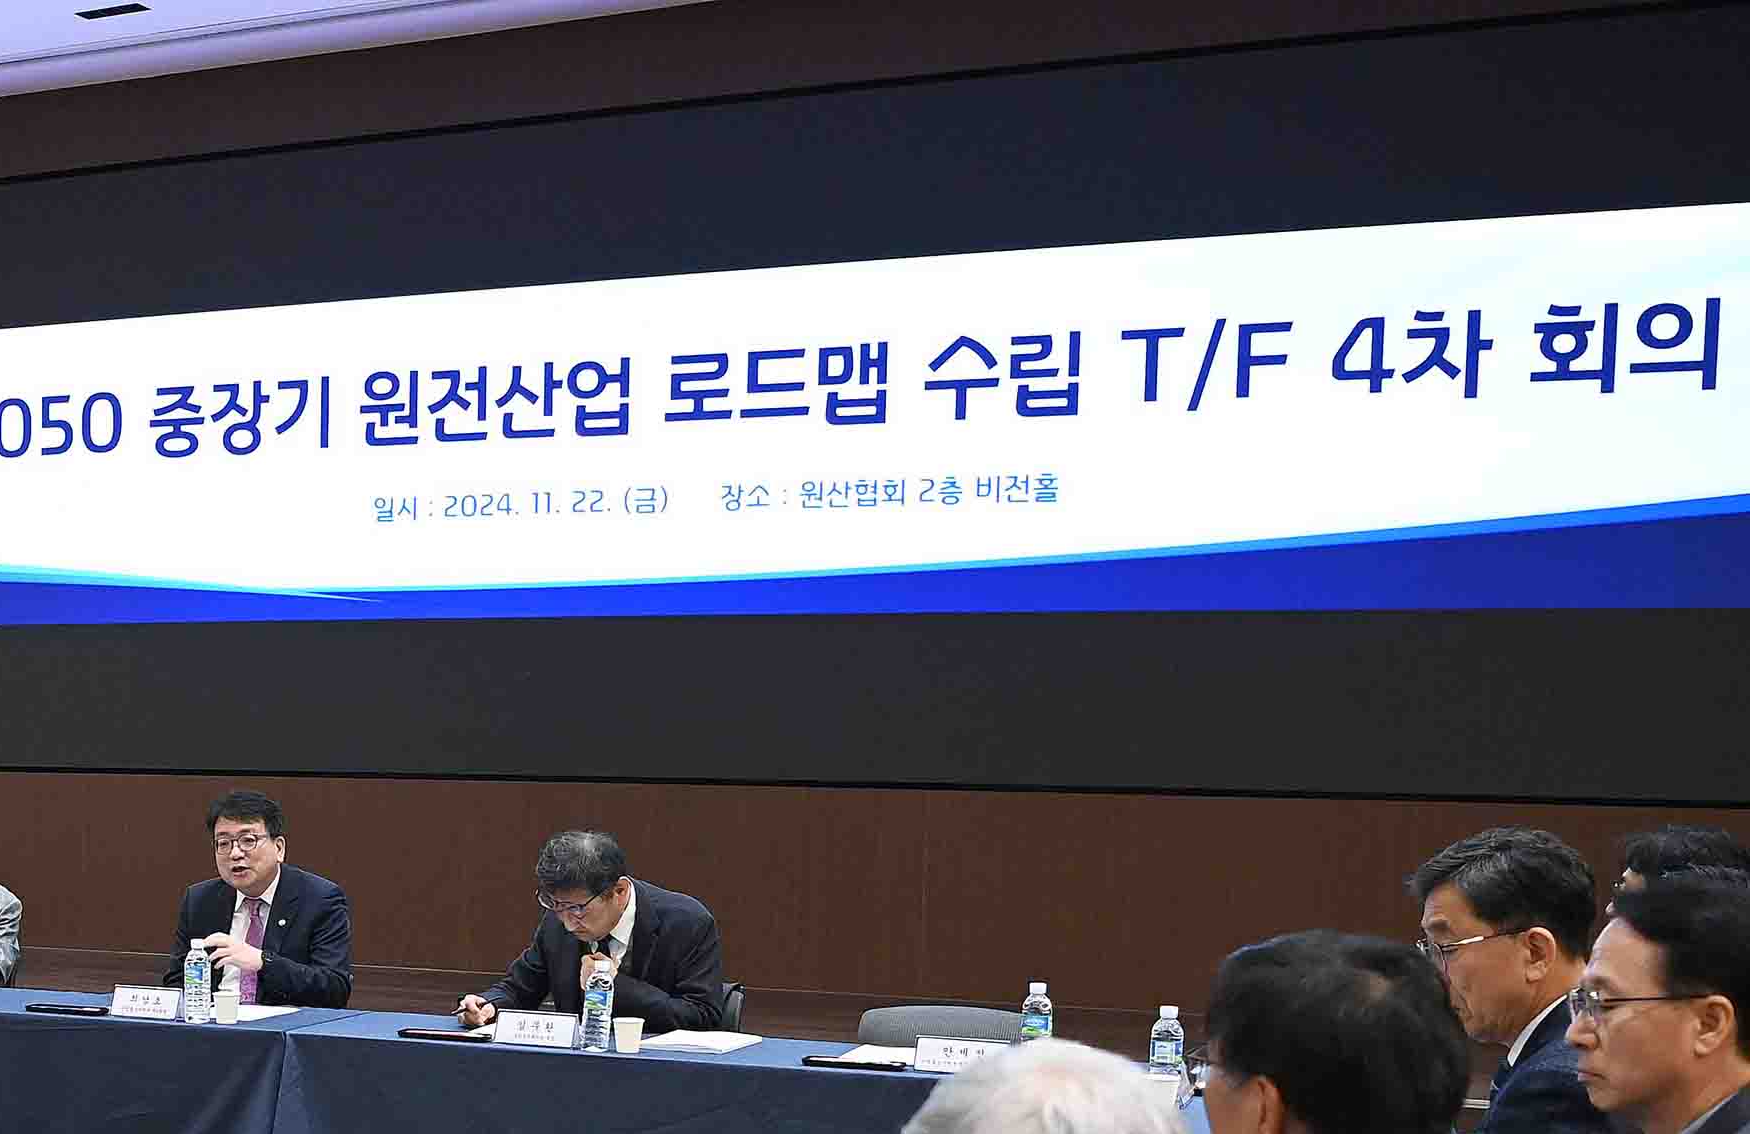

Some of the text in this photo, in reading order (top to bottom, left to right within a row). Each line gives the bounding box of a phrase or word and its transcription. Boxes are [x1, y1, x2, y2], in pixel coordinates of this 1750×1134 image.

[149, 375, 330, 459] 중장기
[359, 356, 631, 447] 원전산업
[664, 341, 889, 426] 로드맵
[924, 330, 1082, 421] 수립
[1121, 318, 1294, 412] T/F
[1331, 309, 1494, 399] 4차
[1529, 297, 1721, 394] 회의
[373, 495, 417, 523] 일시
[444, 493, 519, 518] 2024.
[531, 491, 560, 514] 11.
[572, 489, 611, 513] 22.
[624, 486, 668, 514] (금)
[721, 484, 771, 512] 장소
[799, 479, 906, 509] 원산협회
[919, 476, 963, 506] 2층
[976, 472, 1059, 504] 비전홀
